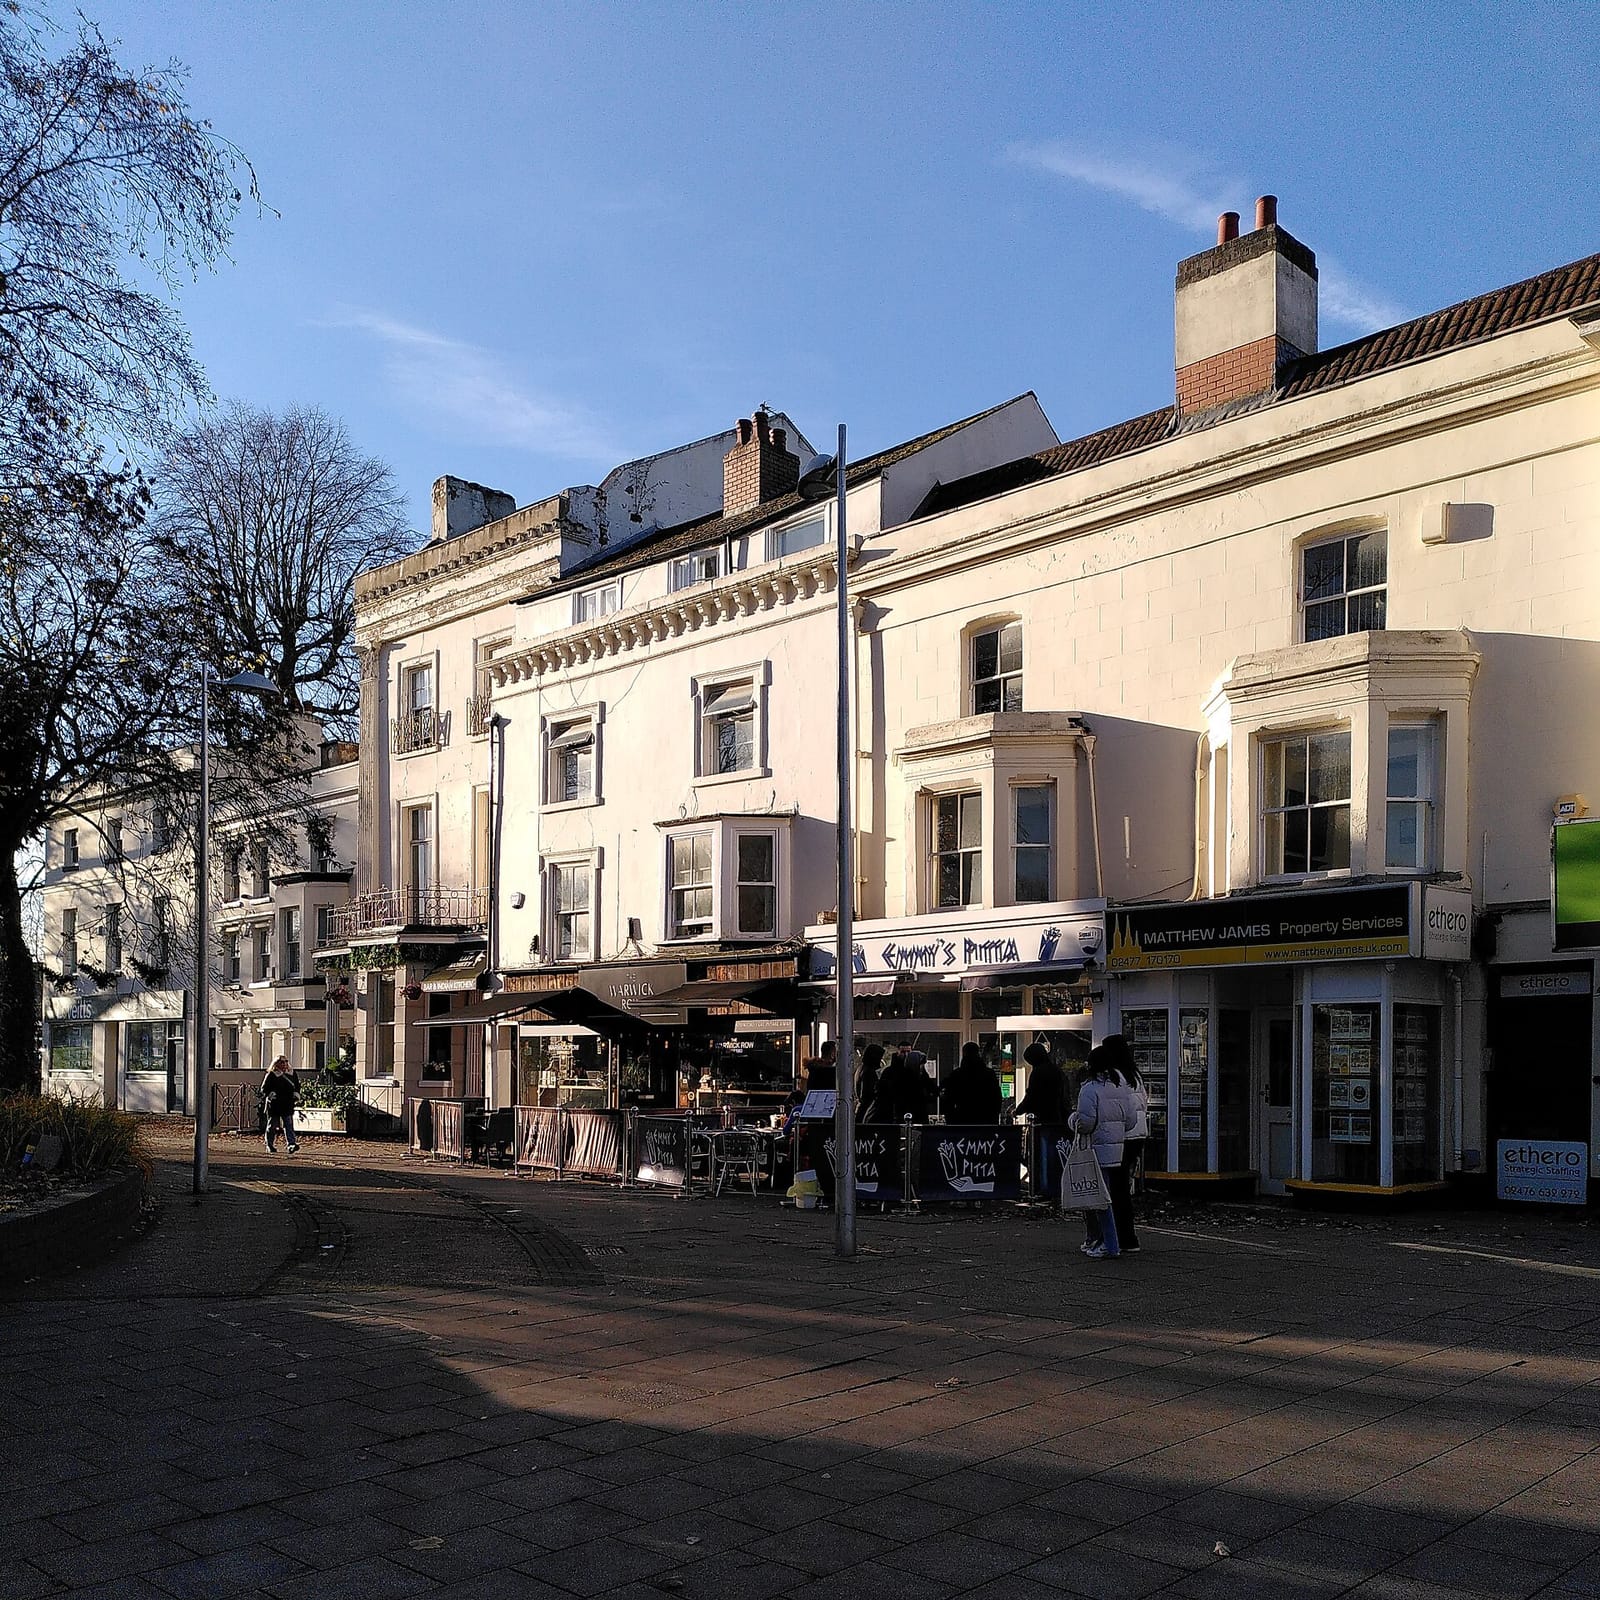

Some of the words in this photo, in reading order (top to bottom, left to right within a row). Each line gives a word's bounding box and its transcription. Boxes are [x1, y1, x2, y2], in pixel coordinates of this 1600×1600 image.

[1560, 804, 1575, 812] ADT
[1428, 905, 1467, 932] ethero
[1144, 928, 1215, 945] MATTHEW
[1219, 924, 1271, 940] JAMES
[1280, 920, 1338, 937] Property
[1342, 915, 1403, 931] Services
[1264, 942, 1403, 958] www.matthewjames.uk.com
[1111, 956, 1140, 967] 02477
[1147, 954, 1180, 965] 170170
[609, 982, 655, 997] WARWICK
[1520, 975, 1570, 989] ethero
[956, 1133, 1006, 1155] EMMY'S
[1504, 1145, 1580, 1166] ethero
[856, 1161, 880, 1177] TTA
[962, 1161, 996, 1177] PITTA
[1503, 1164, 1544, 1176] Strategic
[1546, 1166, 1580, 1178] Staffing
[1071, 1176, 1098, 1191] wbs
[1503, 1185, 1535, 1196] 02476
